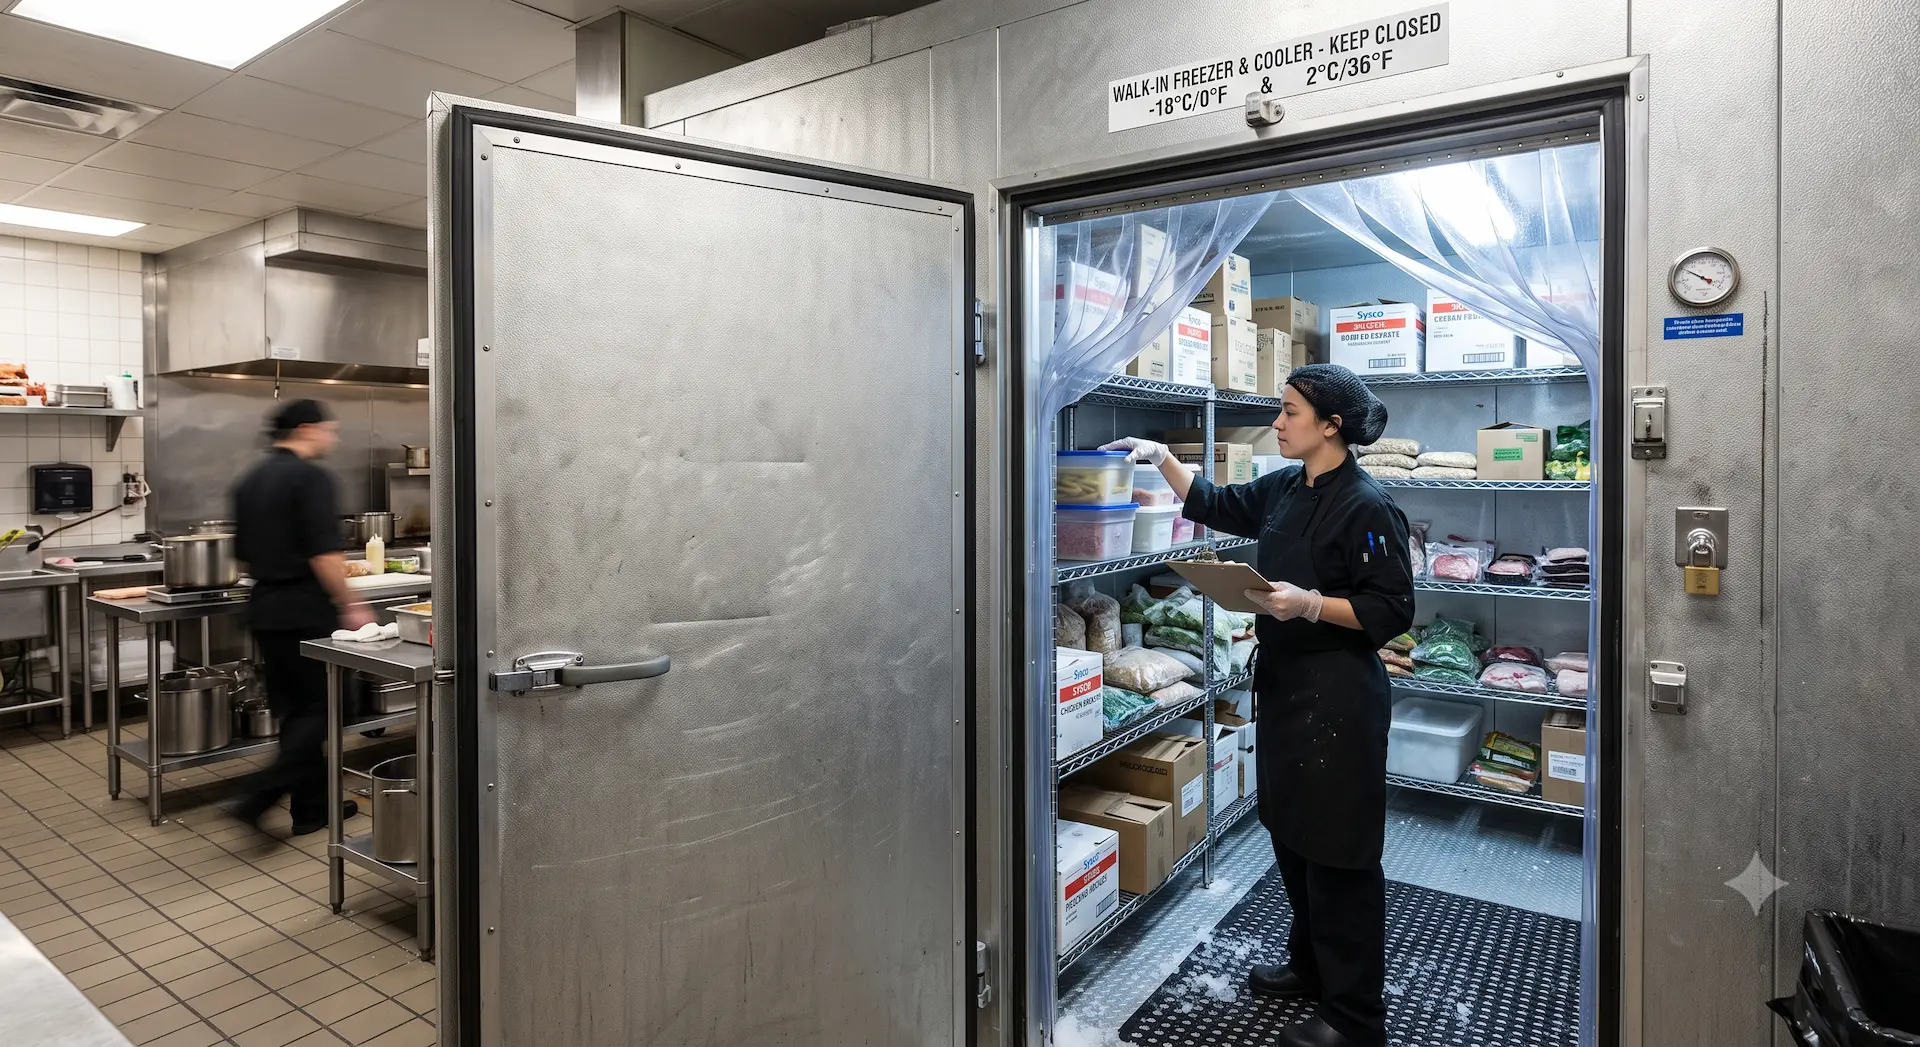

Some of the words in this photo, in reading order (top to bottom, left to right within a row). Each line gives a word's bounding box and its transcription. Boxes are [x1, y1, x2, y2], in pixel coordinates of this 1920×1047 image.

[1113, 75, 1168, 102] WALK-IN
[1174, 60, 1233, 90] FREEZER
[1239, 57, 1249, 75] &
[1254, 42, 1313, 71] COOLER
[1330, 29, 1369, 55] KEEP
[1375, 12, 1441, 45] CLOSED
[1261, 76, 1273, 94] &
[1357, 311, 1384, 320] Sysco
